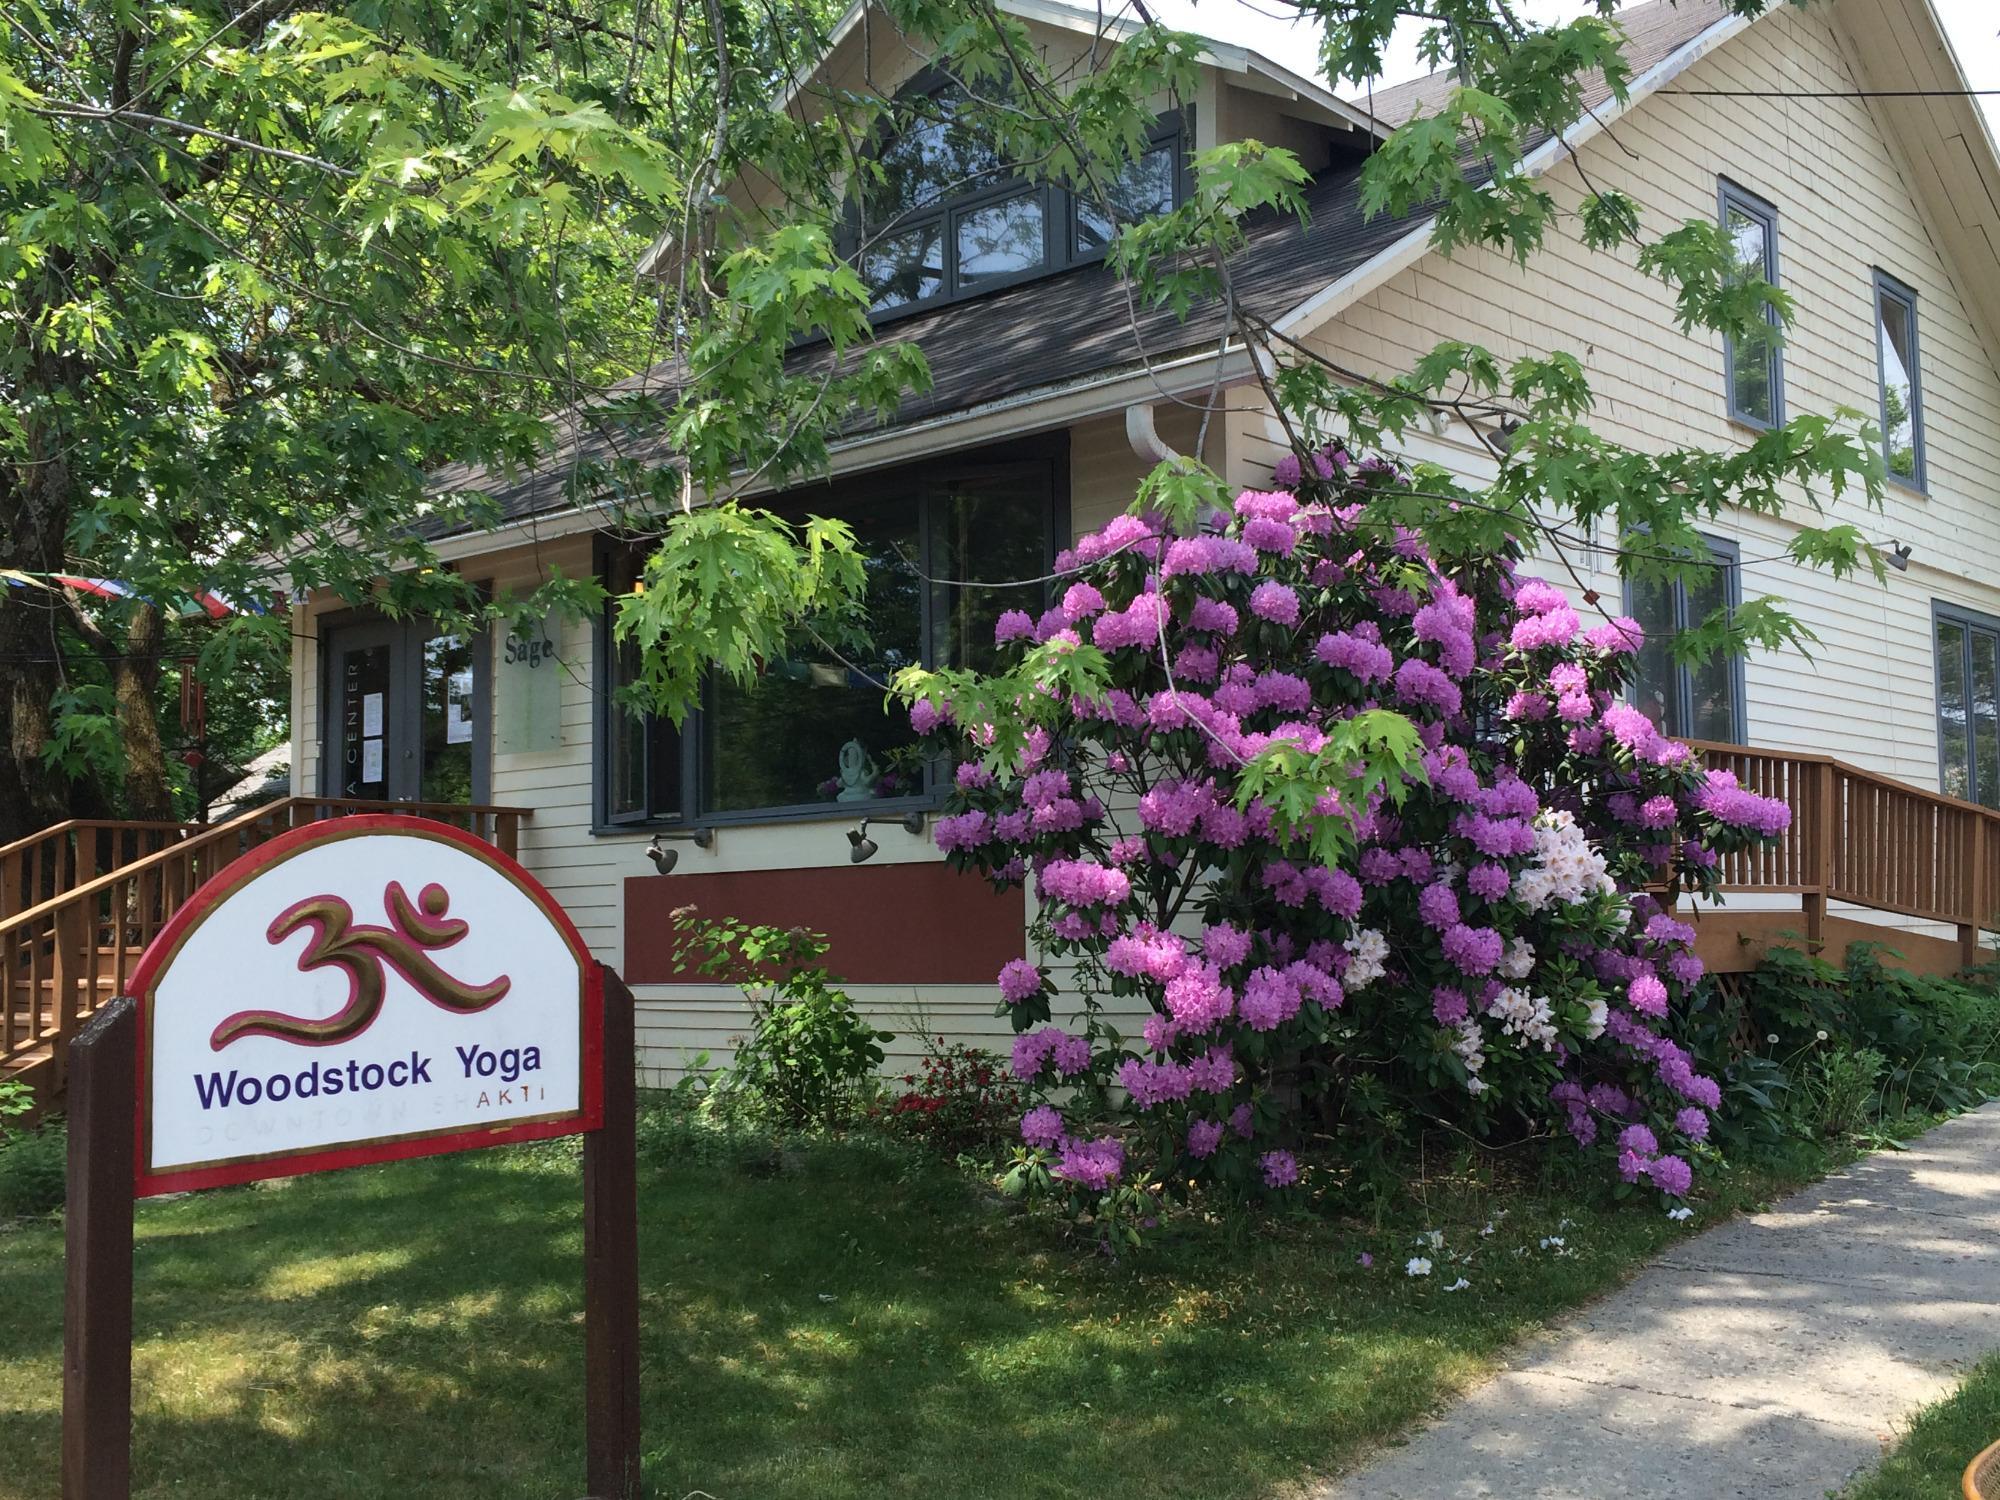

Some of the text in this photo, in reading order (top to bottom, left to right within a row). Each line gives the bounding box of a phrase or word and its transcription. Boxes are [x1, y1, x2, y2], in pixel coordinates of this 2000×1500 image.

[504, 635, 553, 669] Sage
[346, 663, 359, 764] CENTER
[194, 1044, 542, 1111] Woodstock Yoga
